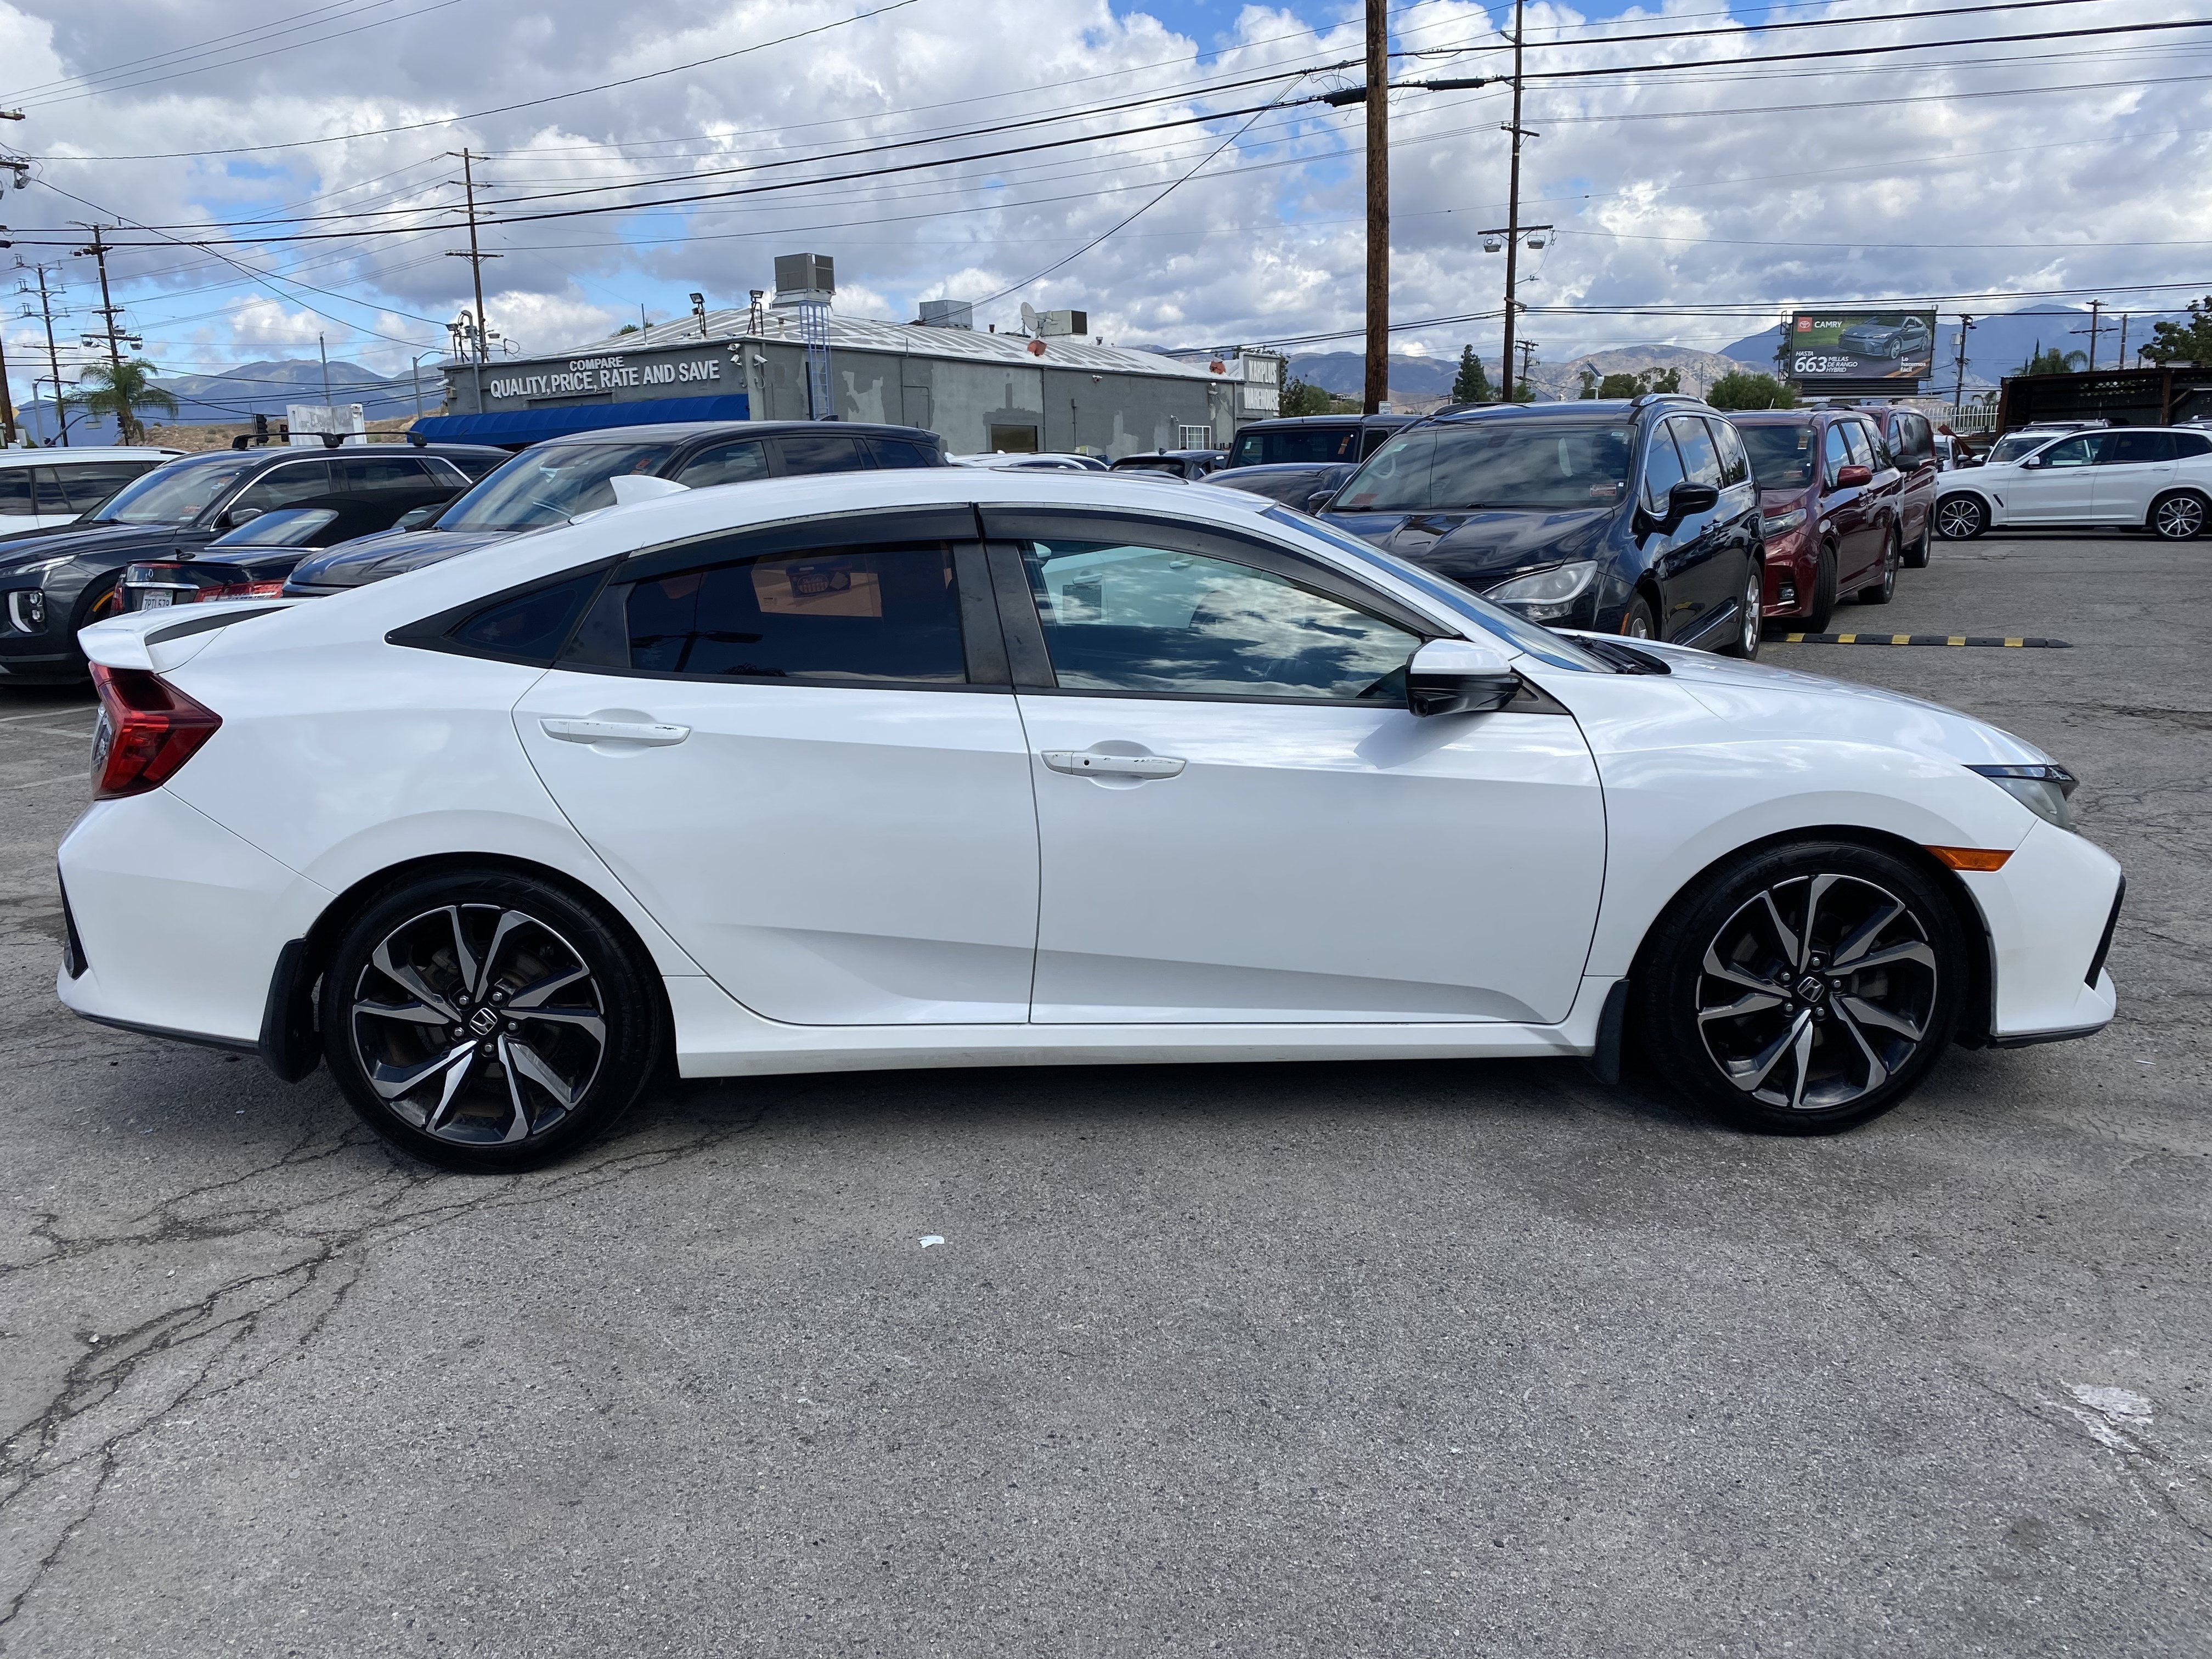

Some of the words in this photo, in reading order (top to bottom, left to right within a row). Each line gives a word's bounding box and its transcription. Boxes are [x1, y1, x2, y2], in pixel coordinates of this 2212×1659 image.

[569, 356, 624, 371] COMPARE
[1248, 360, 1277, 383] KARPLUS
[1795, 356, 1827, 373] 663
[490, 375, 551, 399] QUALITY,
[551, 371, 598, 392] PRICE,
[600, 366, 640, 388] RATE
[642, 364, 676, 385] AND
[678, 359, 721, 382] SAVE
[1244, 387, 1280, 411] WAREHOUSE
